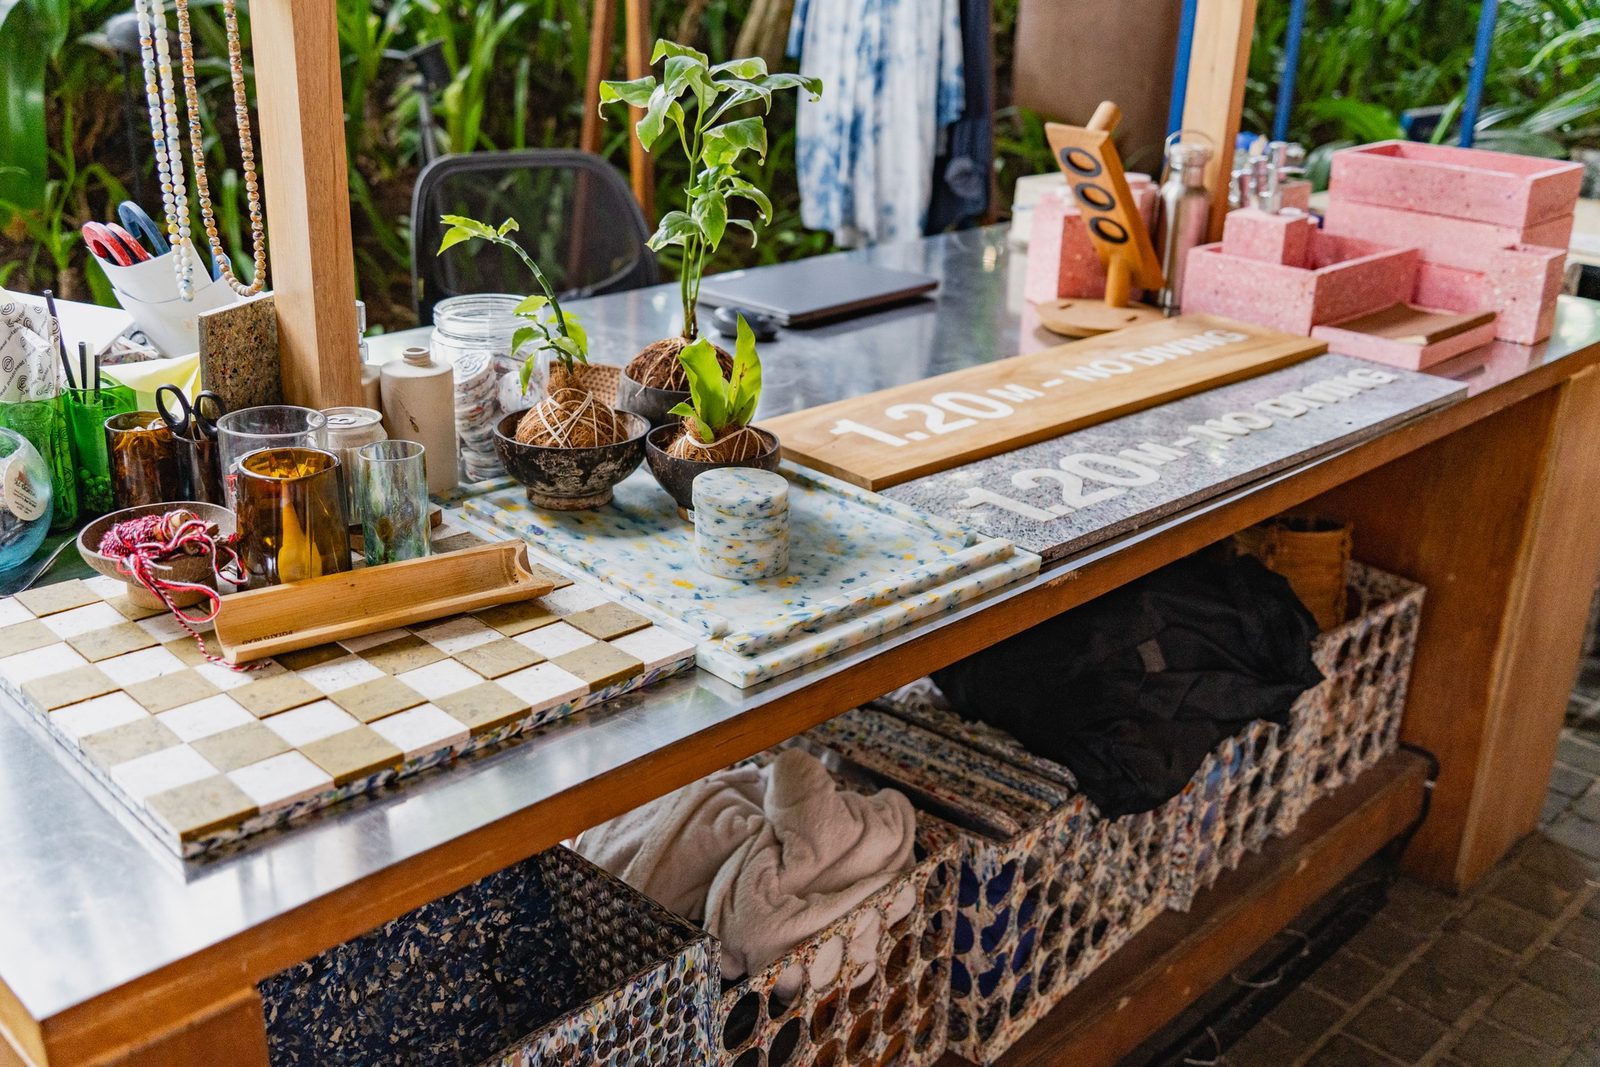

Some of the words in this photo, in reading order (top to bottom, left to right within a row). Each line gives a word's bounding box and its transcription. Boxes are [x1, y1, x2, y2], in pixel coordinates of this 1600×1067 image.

[1061, 359, 1134, 382] NO
[1120, 329, 1249, 366] DIVING
[1187, 412, 1274, 442] NO
[1254, 368, 1400, 418] DIVING
[263, 630, 293, 640] POTATO
